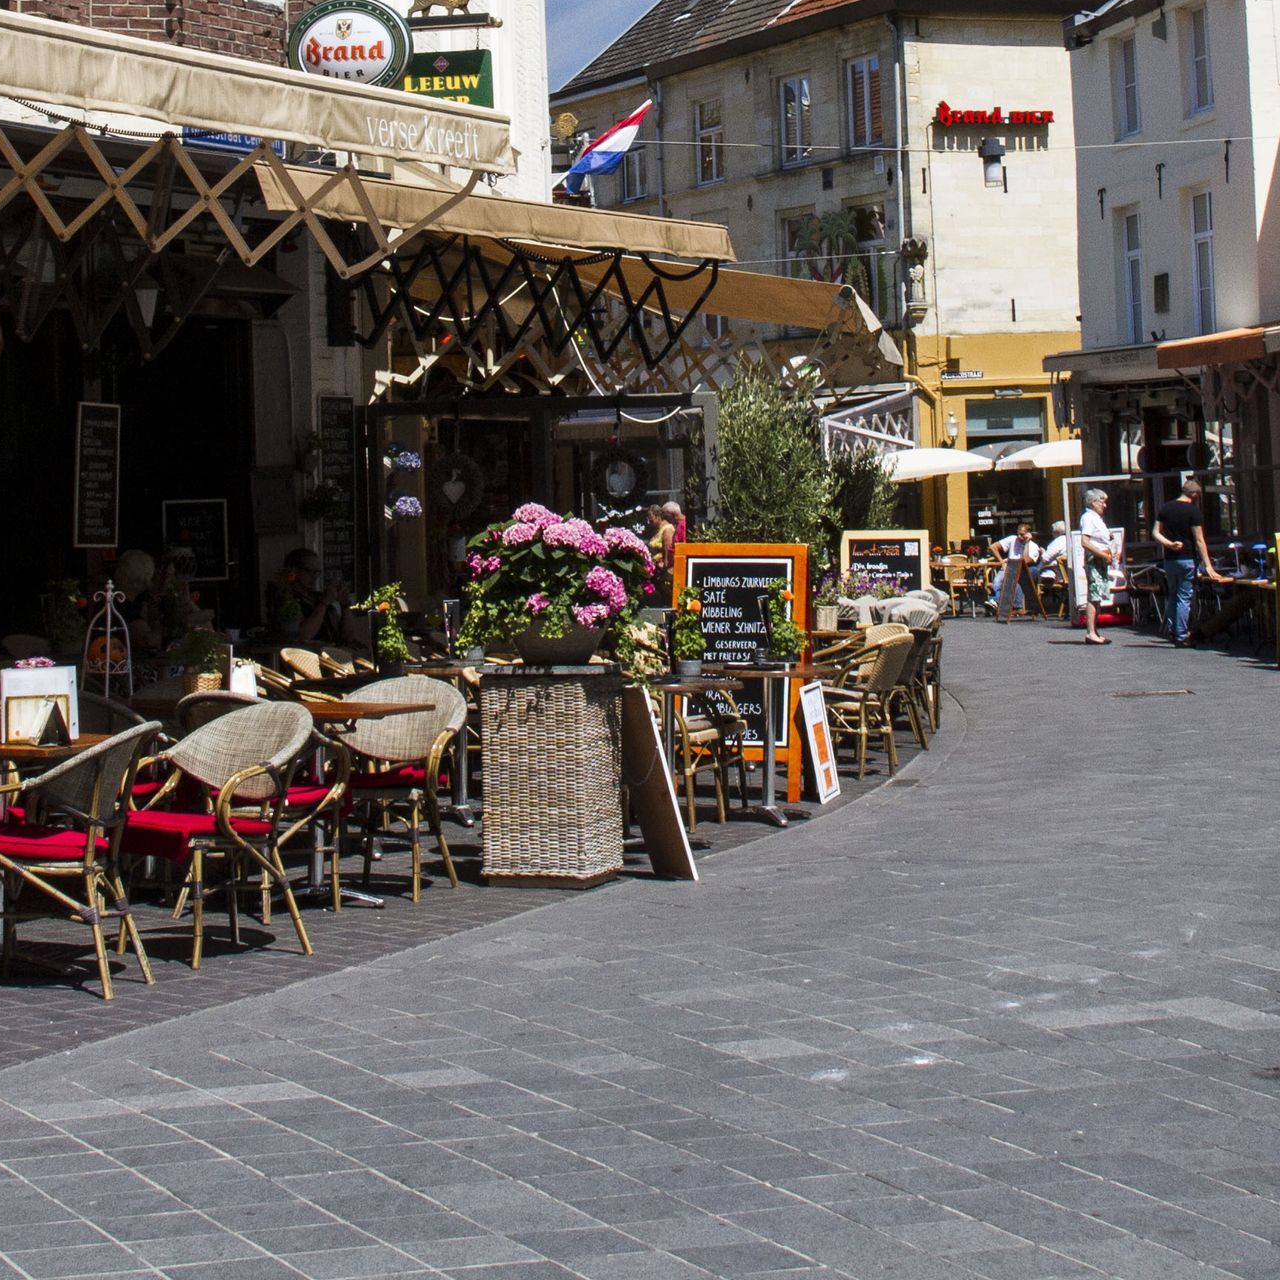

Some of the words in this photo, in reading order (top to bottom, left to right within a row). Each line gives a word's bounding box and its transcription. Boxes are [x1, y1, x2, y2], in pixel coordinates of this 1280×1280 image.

[306, 36, 385, 66] Brand
[323, 69, 365, 79] BIER
[404, 74, 481, 93] LEEUW
[936, 100, 1003, 127] Brand
[1009, 108, 1055, 124] BIER
[367, 116, 418, 152] verse
[423, 113, 480, 161] kreeft
[703, 589, 726, 603] SATÉ
[702, 606, 743, 618] KIBBELING
[701, 622, 731, 634] WIENER
[734, 622, 770, 633] SCHNITZ
[715, 640, 757, 649] GESERVEERD
[703, 652, 717, 660] MET
